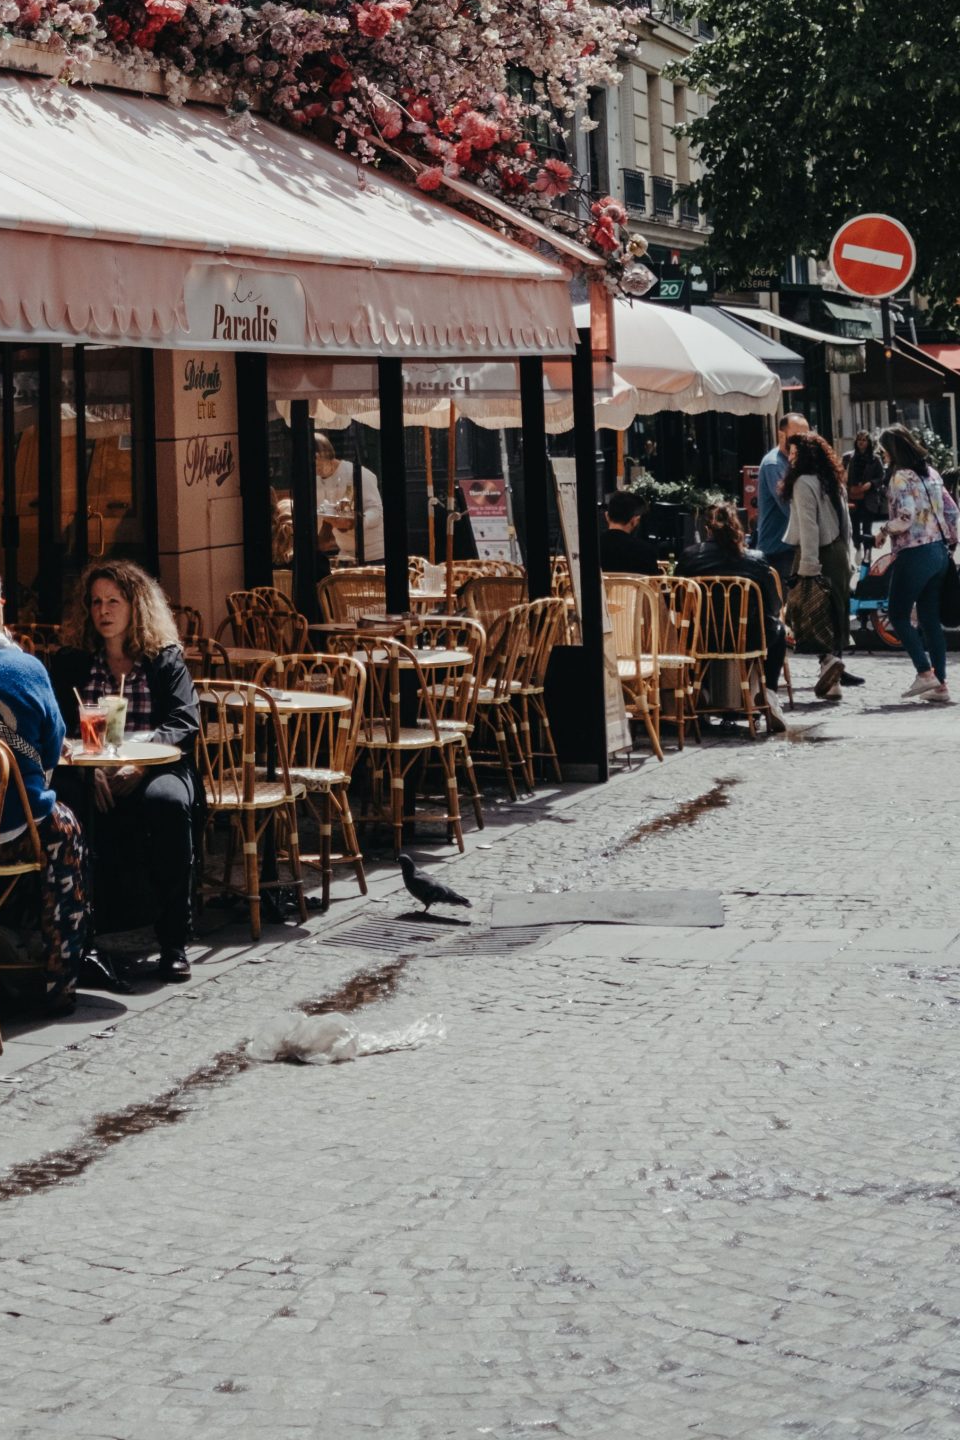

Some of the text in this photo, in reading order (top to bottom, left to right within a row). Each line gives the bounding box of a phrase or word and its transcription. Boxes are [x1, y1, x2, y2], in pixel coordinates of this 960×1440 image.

[232, 274, 262, 303] Le
[212, 304, 278, 343] Paradis
[184, 435, 234, 487] Plaisir
